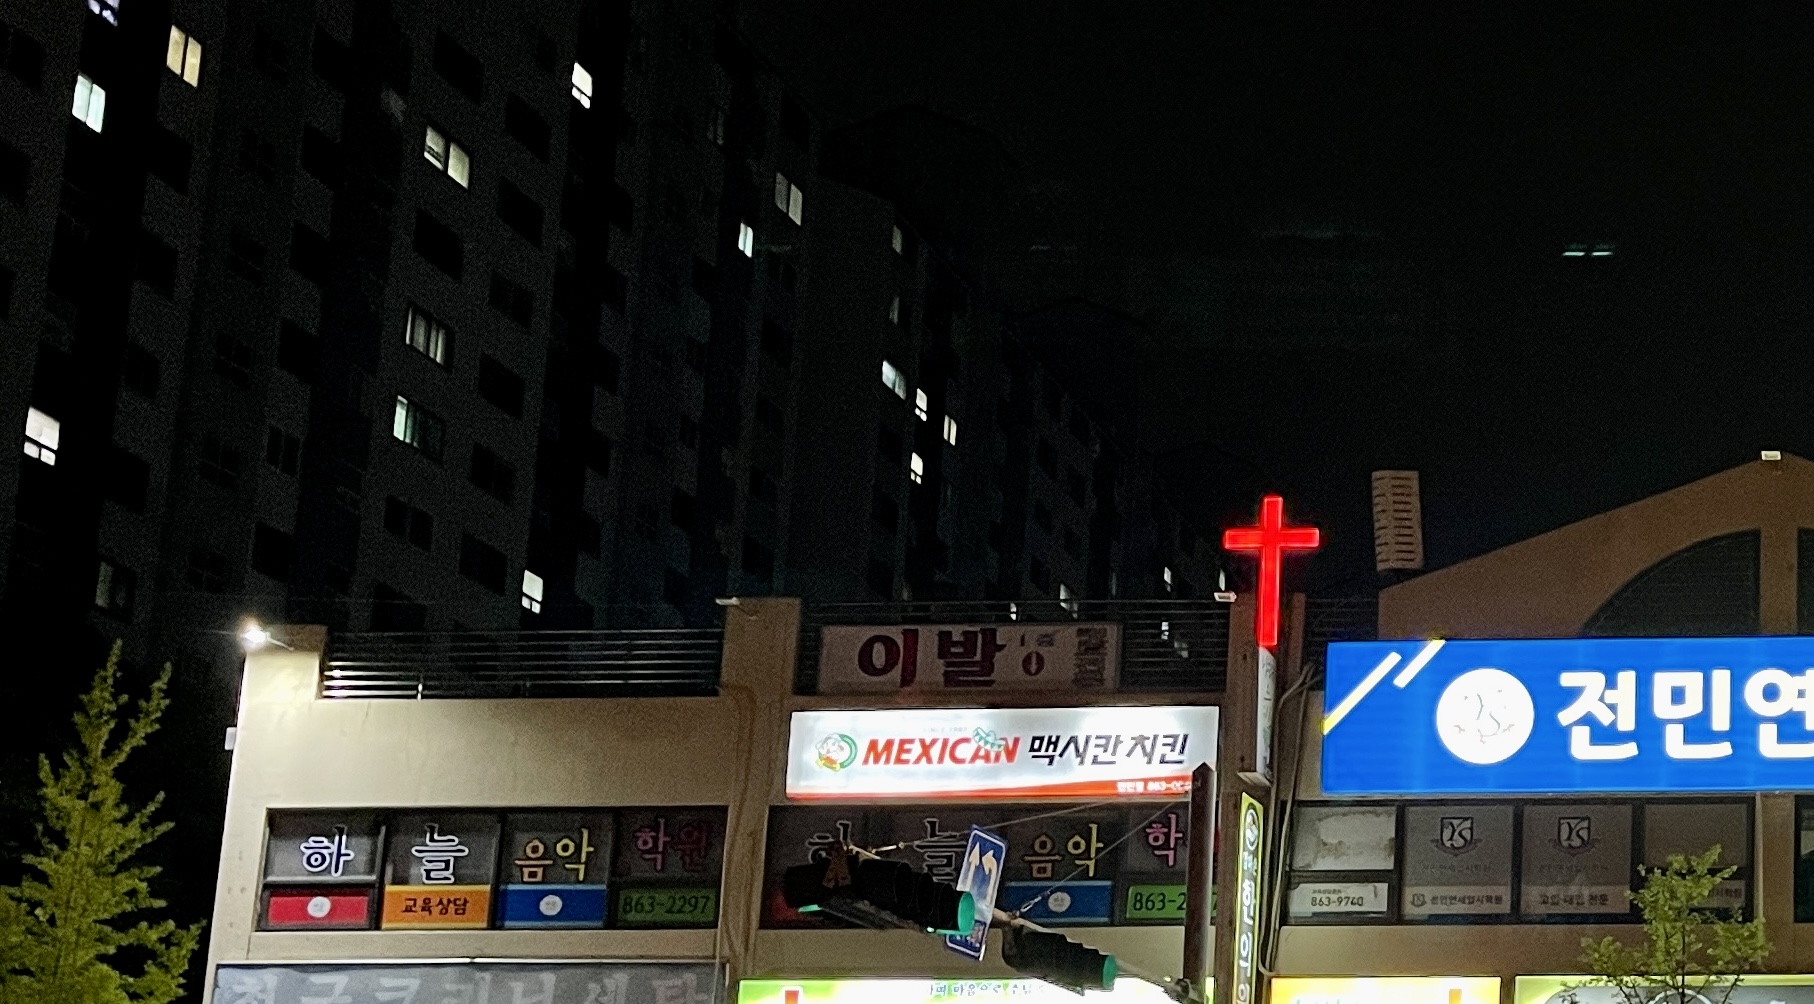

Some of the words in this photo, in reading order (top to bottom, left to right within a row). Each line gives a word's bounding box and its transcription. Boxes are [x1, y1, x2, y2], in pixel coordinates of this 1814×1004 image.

[857, 627, 1006, 688] 이발
[861, 736, 1021, 766] MEXICAN
[514, 828, 594, 883] 음악
[635, 819, 710, 872] 학원
[1023, 823, 1104, 878] 음악
[1145, 813, 1185, 867] 학
[401, 895, 470, 917] 교육상담
[622, 894, 711, 917] 863-2297
